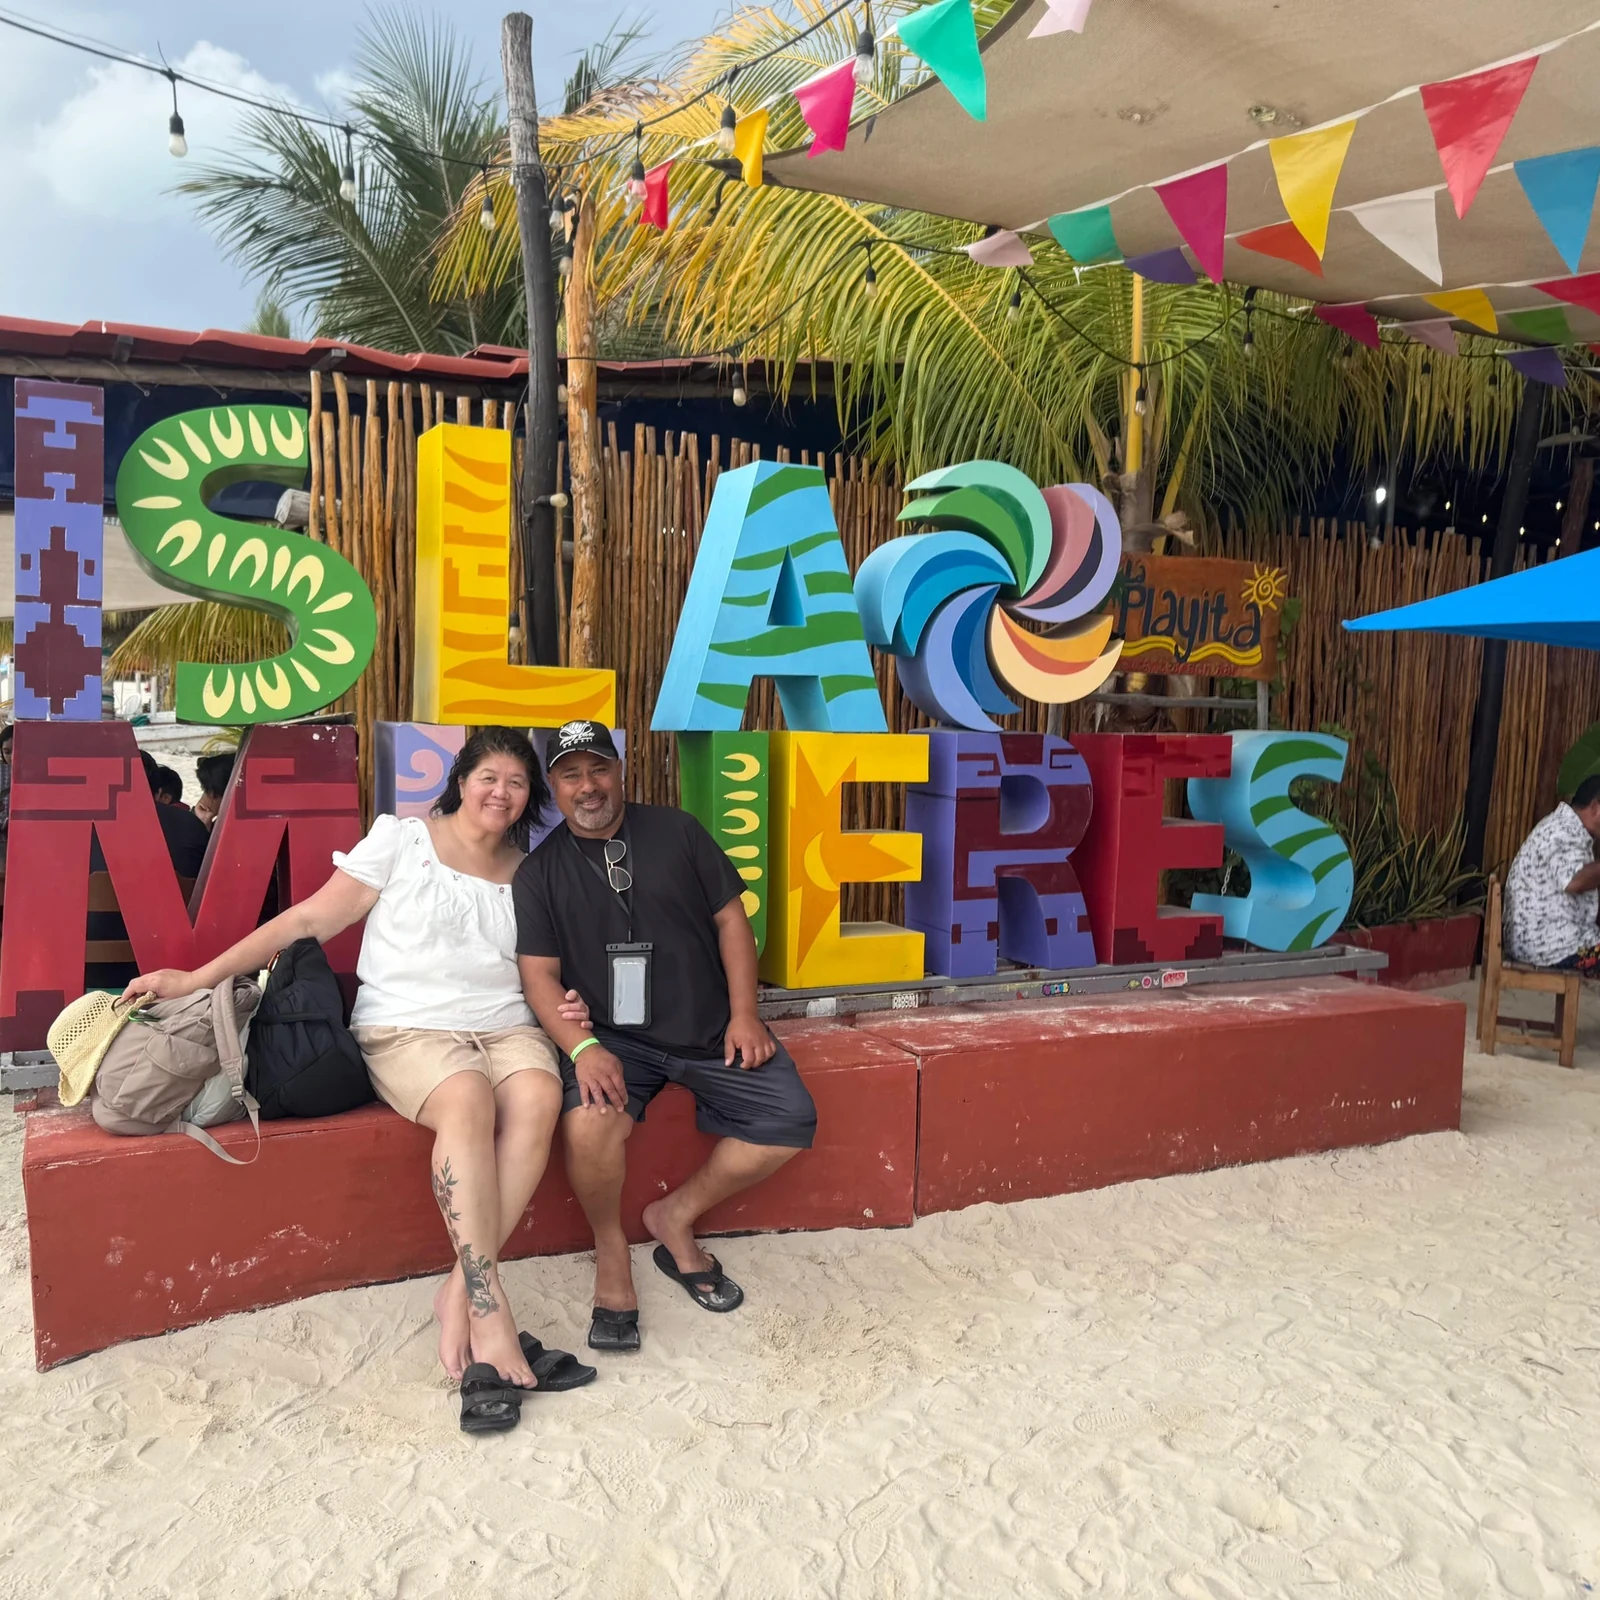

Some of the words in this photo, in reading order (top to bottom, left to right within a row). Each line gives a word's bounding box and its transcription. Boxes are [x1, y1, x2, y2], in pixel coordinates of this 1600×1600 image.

[14, 377, 888, 733] ISLA
[1124, 558, 1146, 584] La
[1117, 585, 1261, 663] Playita
